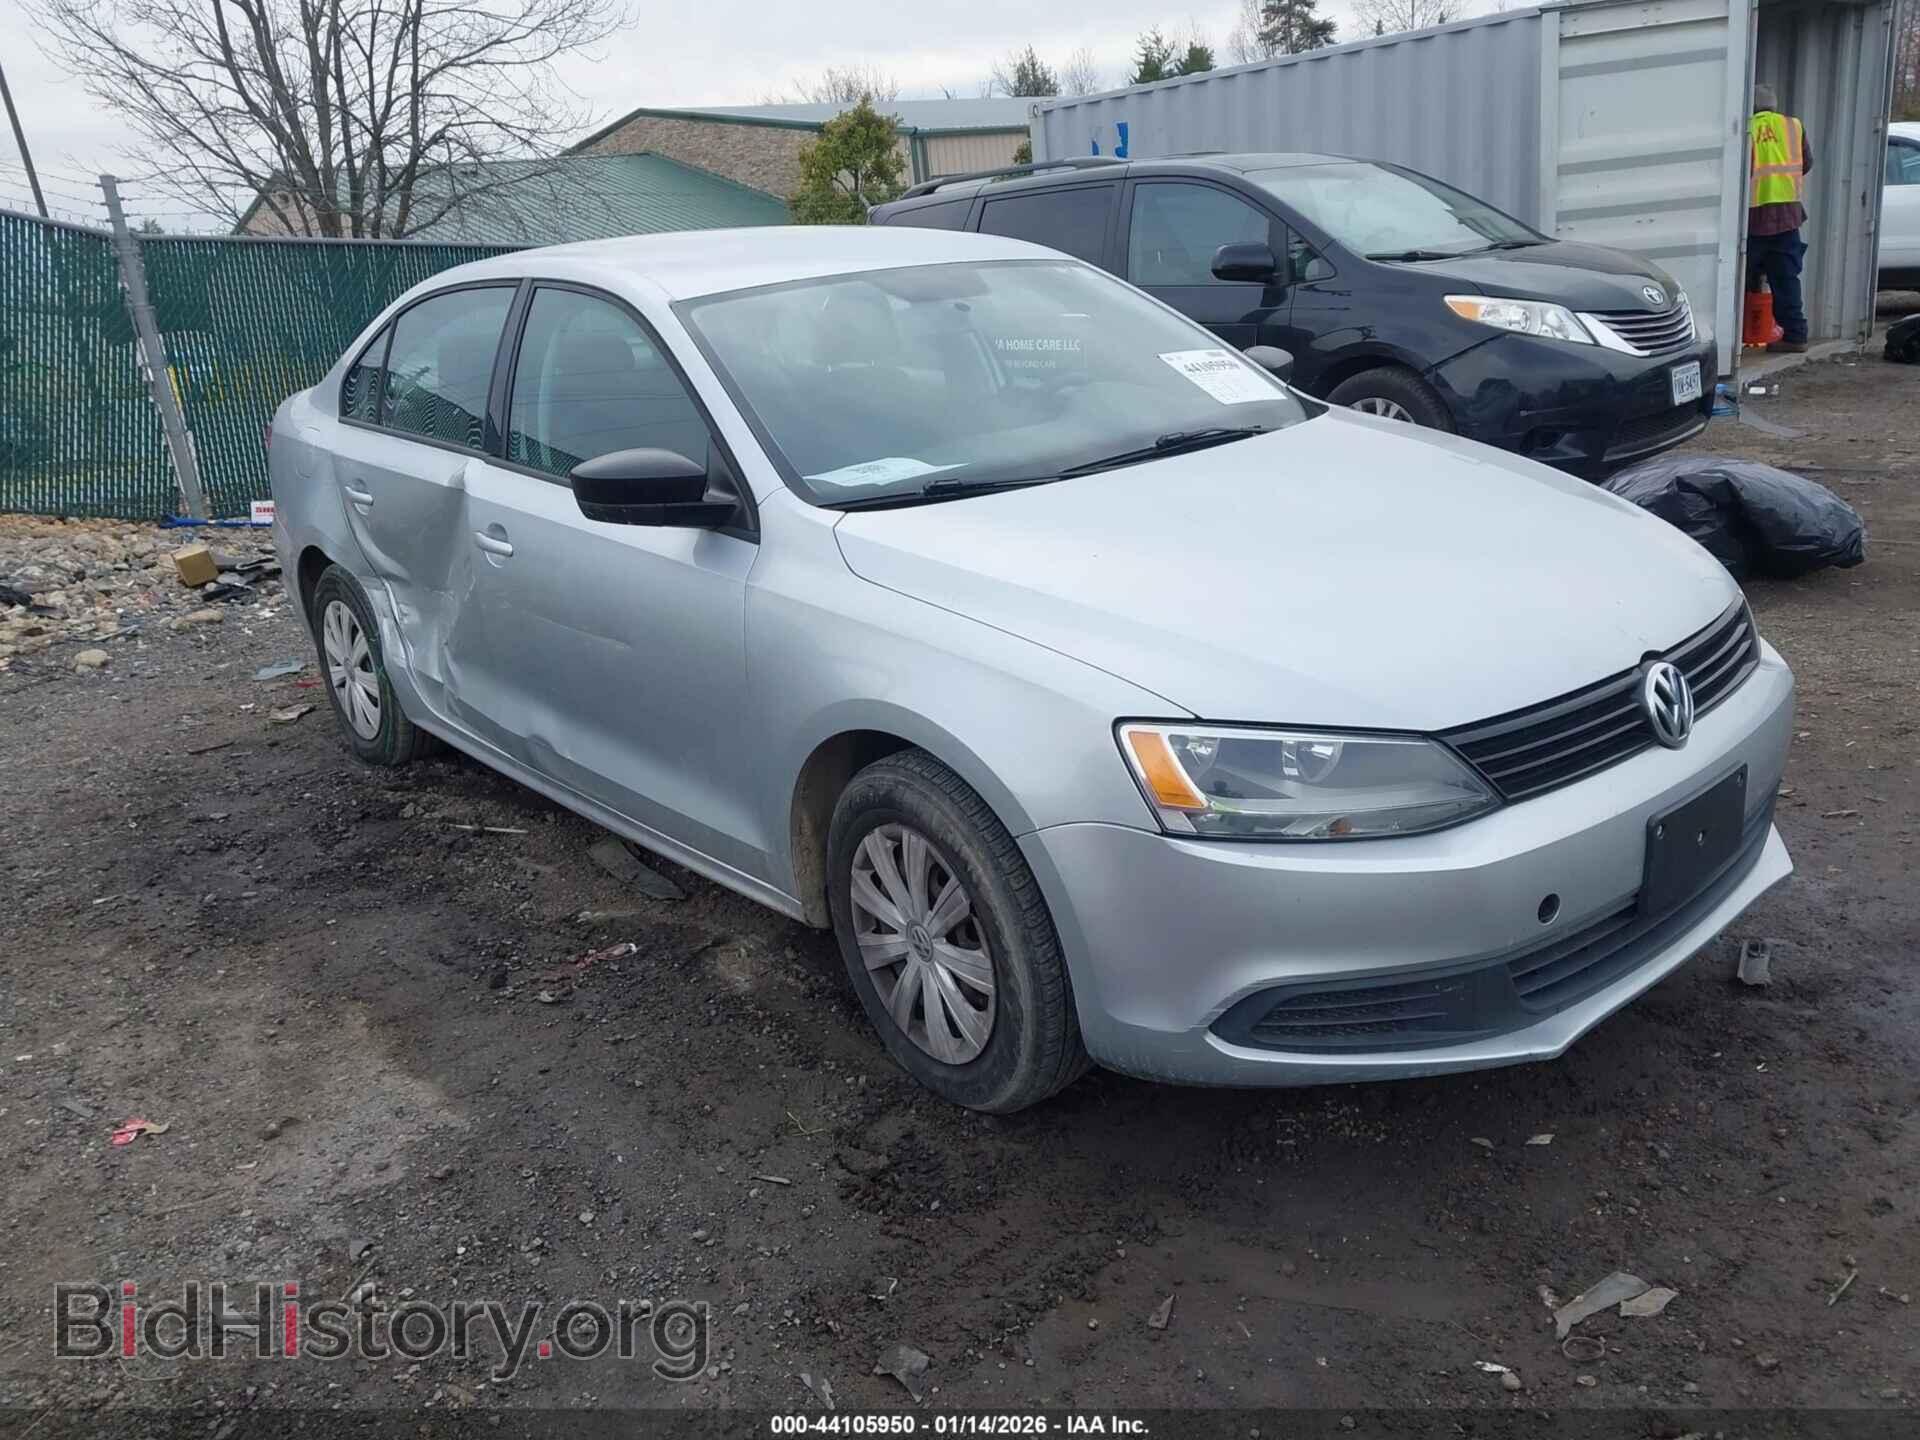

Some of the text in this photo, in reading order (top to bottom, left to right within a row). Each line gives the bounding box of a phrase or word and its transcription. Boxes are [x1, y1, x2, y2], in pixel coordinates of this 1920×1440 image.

[1006, 339, 1034, 351] HOME
[1036, 339, 1063, 351] CARE
[1063, 339, 1081, 351] LLC
